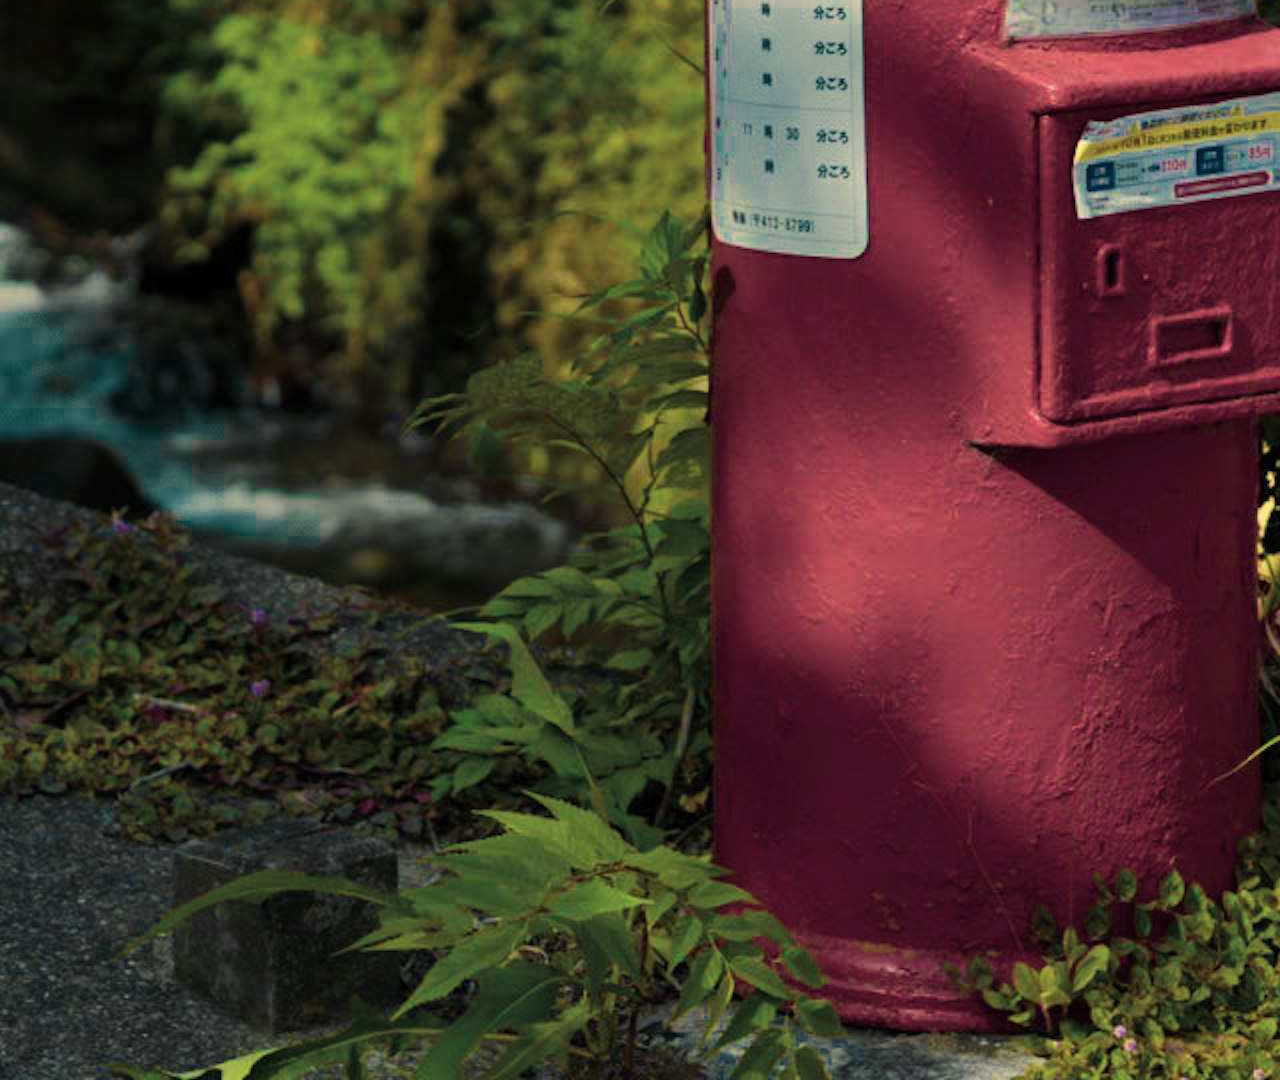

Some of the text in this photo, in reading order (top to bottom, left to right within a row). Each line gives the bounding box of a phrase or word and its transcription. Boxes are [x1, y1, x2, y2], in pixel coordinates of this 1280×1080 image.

[814, 6, 847, 21] 分ごろ
[814, 41, 848, 56] 分ごろ
[815, 76, 849, 91] 分ごろ
[786, 127, 800, 141] 30
[816, 128, 849, 145] 分ごろ
[817, 164, 851, 180] 分ごろ
